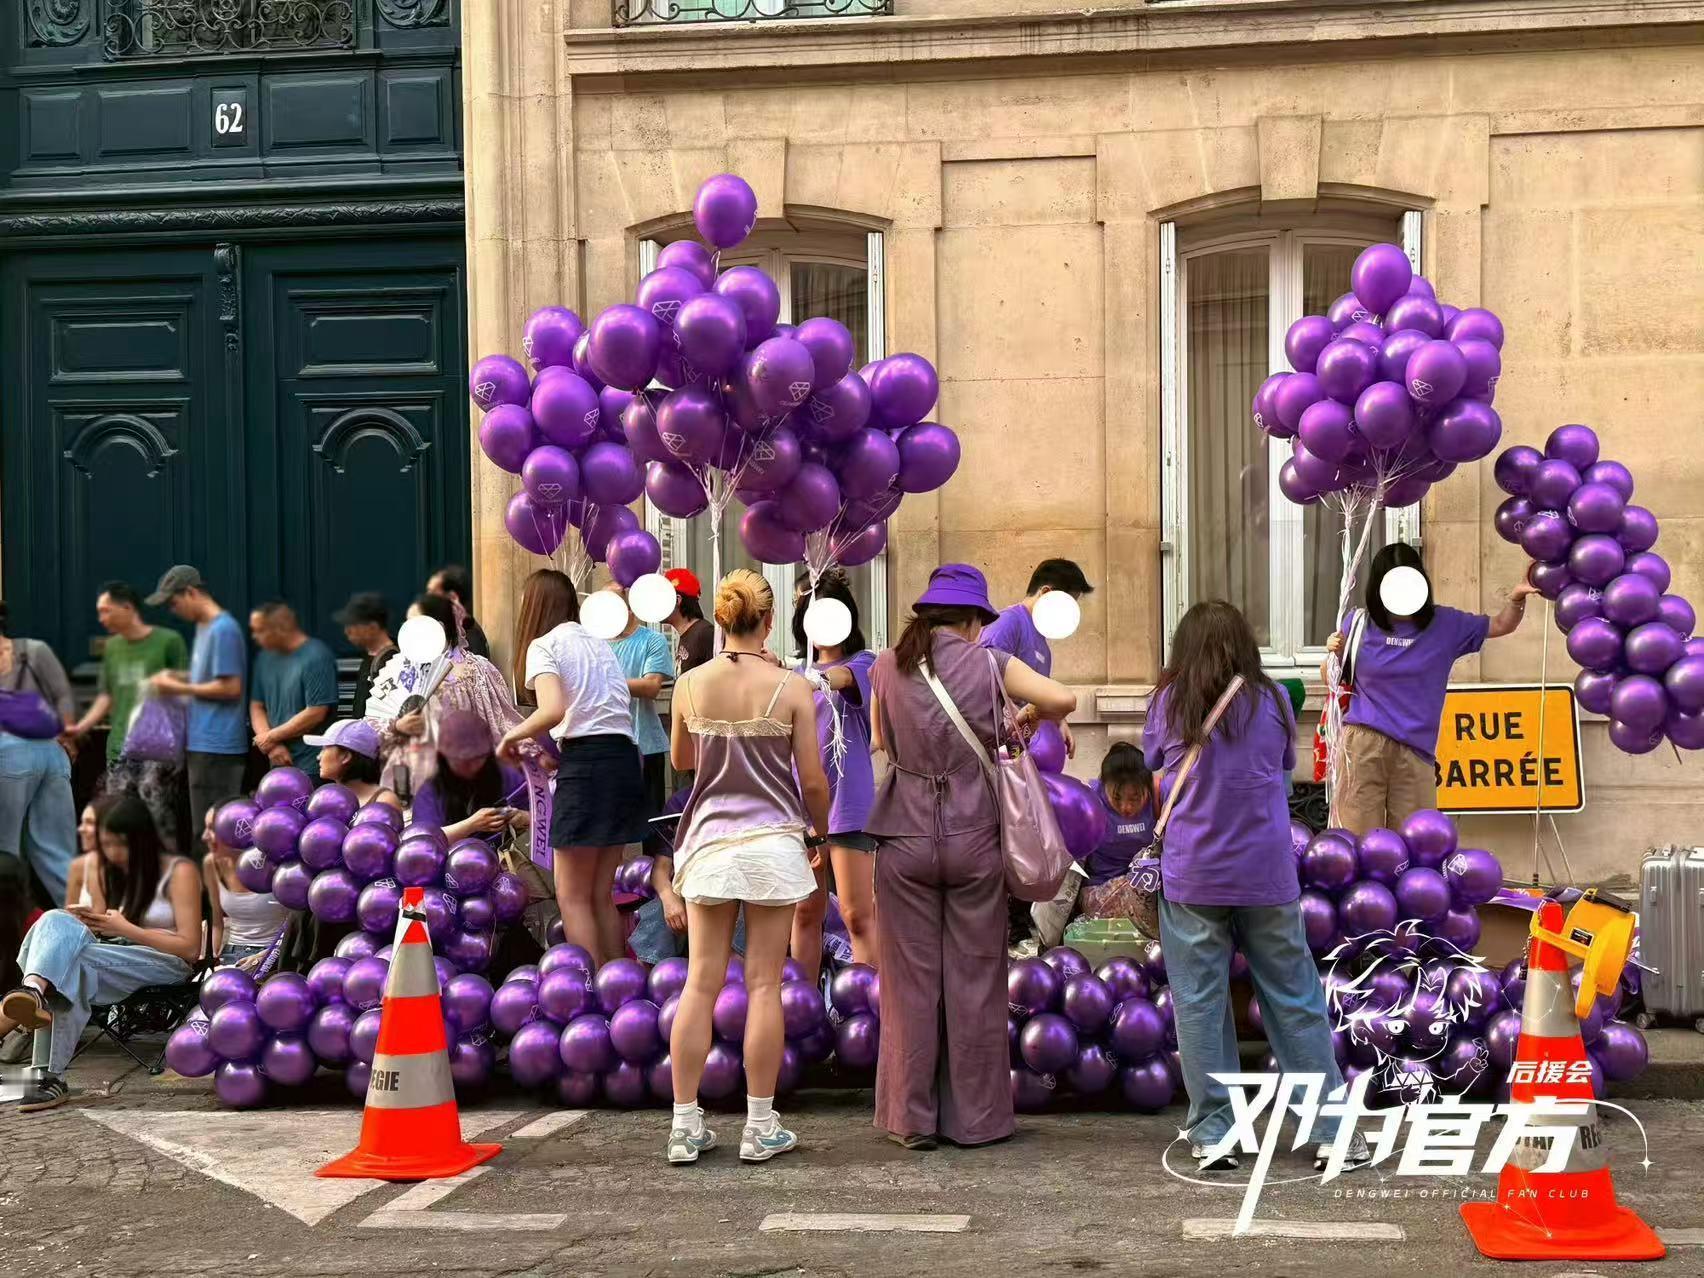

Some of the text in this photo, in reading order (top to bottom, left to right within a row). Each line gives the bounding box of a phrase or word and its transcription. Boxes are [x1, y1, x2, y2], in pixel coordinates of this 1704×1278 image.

[215, 103, 243, 134] 62
[1455, 712, 1524, 740] RUE
[531, 762, 547, 857] NGWEI
